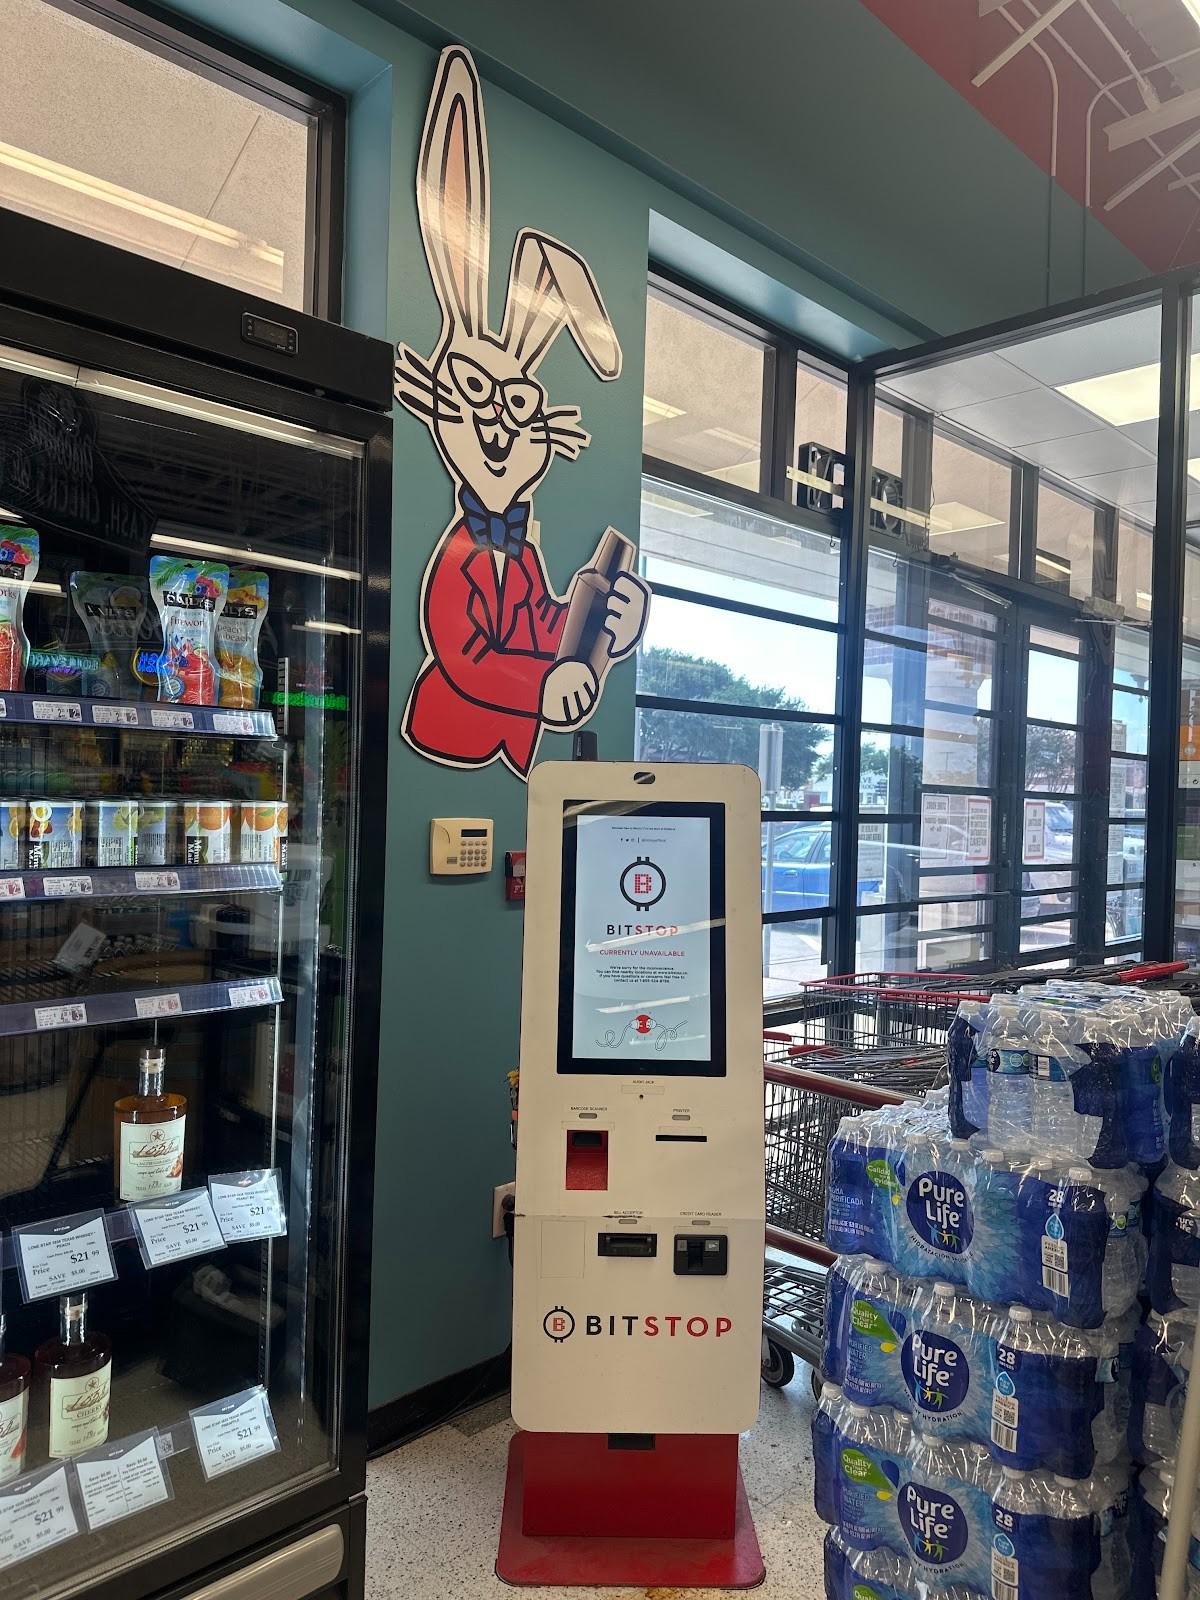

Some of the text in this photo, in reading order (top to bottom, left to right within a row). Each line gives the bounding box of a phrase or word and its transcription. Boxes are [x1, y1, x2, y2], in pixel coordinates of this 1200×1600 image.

[607, 924, 679, 937] BITSTOP
[600, 949, 638, 957] CURRENTLY
[918, 1177, 965, 1208] Pure
[1048, 1189, 1065, 1204] 28
[249, 1206, 265, 1217] $21
[925, 1199, 960, 1230] Life
[182, 1222, 200, 1234] $21
[70, 1251, 89, 1265] $21
[32, 1266, 50, 1276] Price
[48, 1273, 66, 1282] SAVE
[586, 1315, 733, 1338] BITSTOP
[851, 1316, 873, 1330] Clear
[911, 1333, 958, 1367] Pure
[999, 1348, 1016, 1365] 28
[913, 1355, 950, 1387] Life
[237, 1427, 253, 1440] $21
[842, 1453, 872, 1470] Quality
[844, 1464, 868, 1478] Clear
[906, 1485, 955, 1520] Pure
[34, 1508, 54, 1526] $21
[910, 1507, 949, 1539] Life
[995, 1508, 1014, 1529] 28
